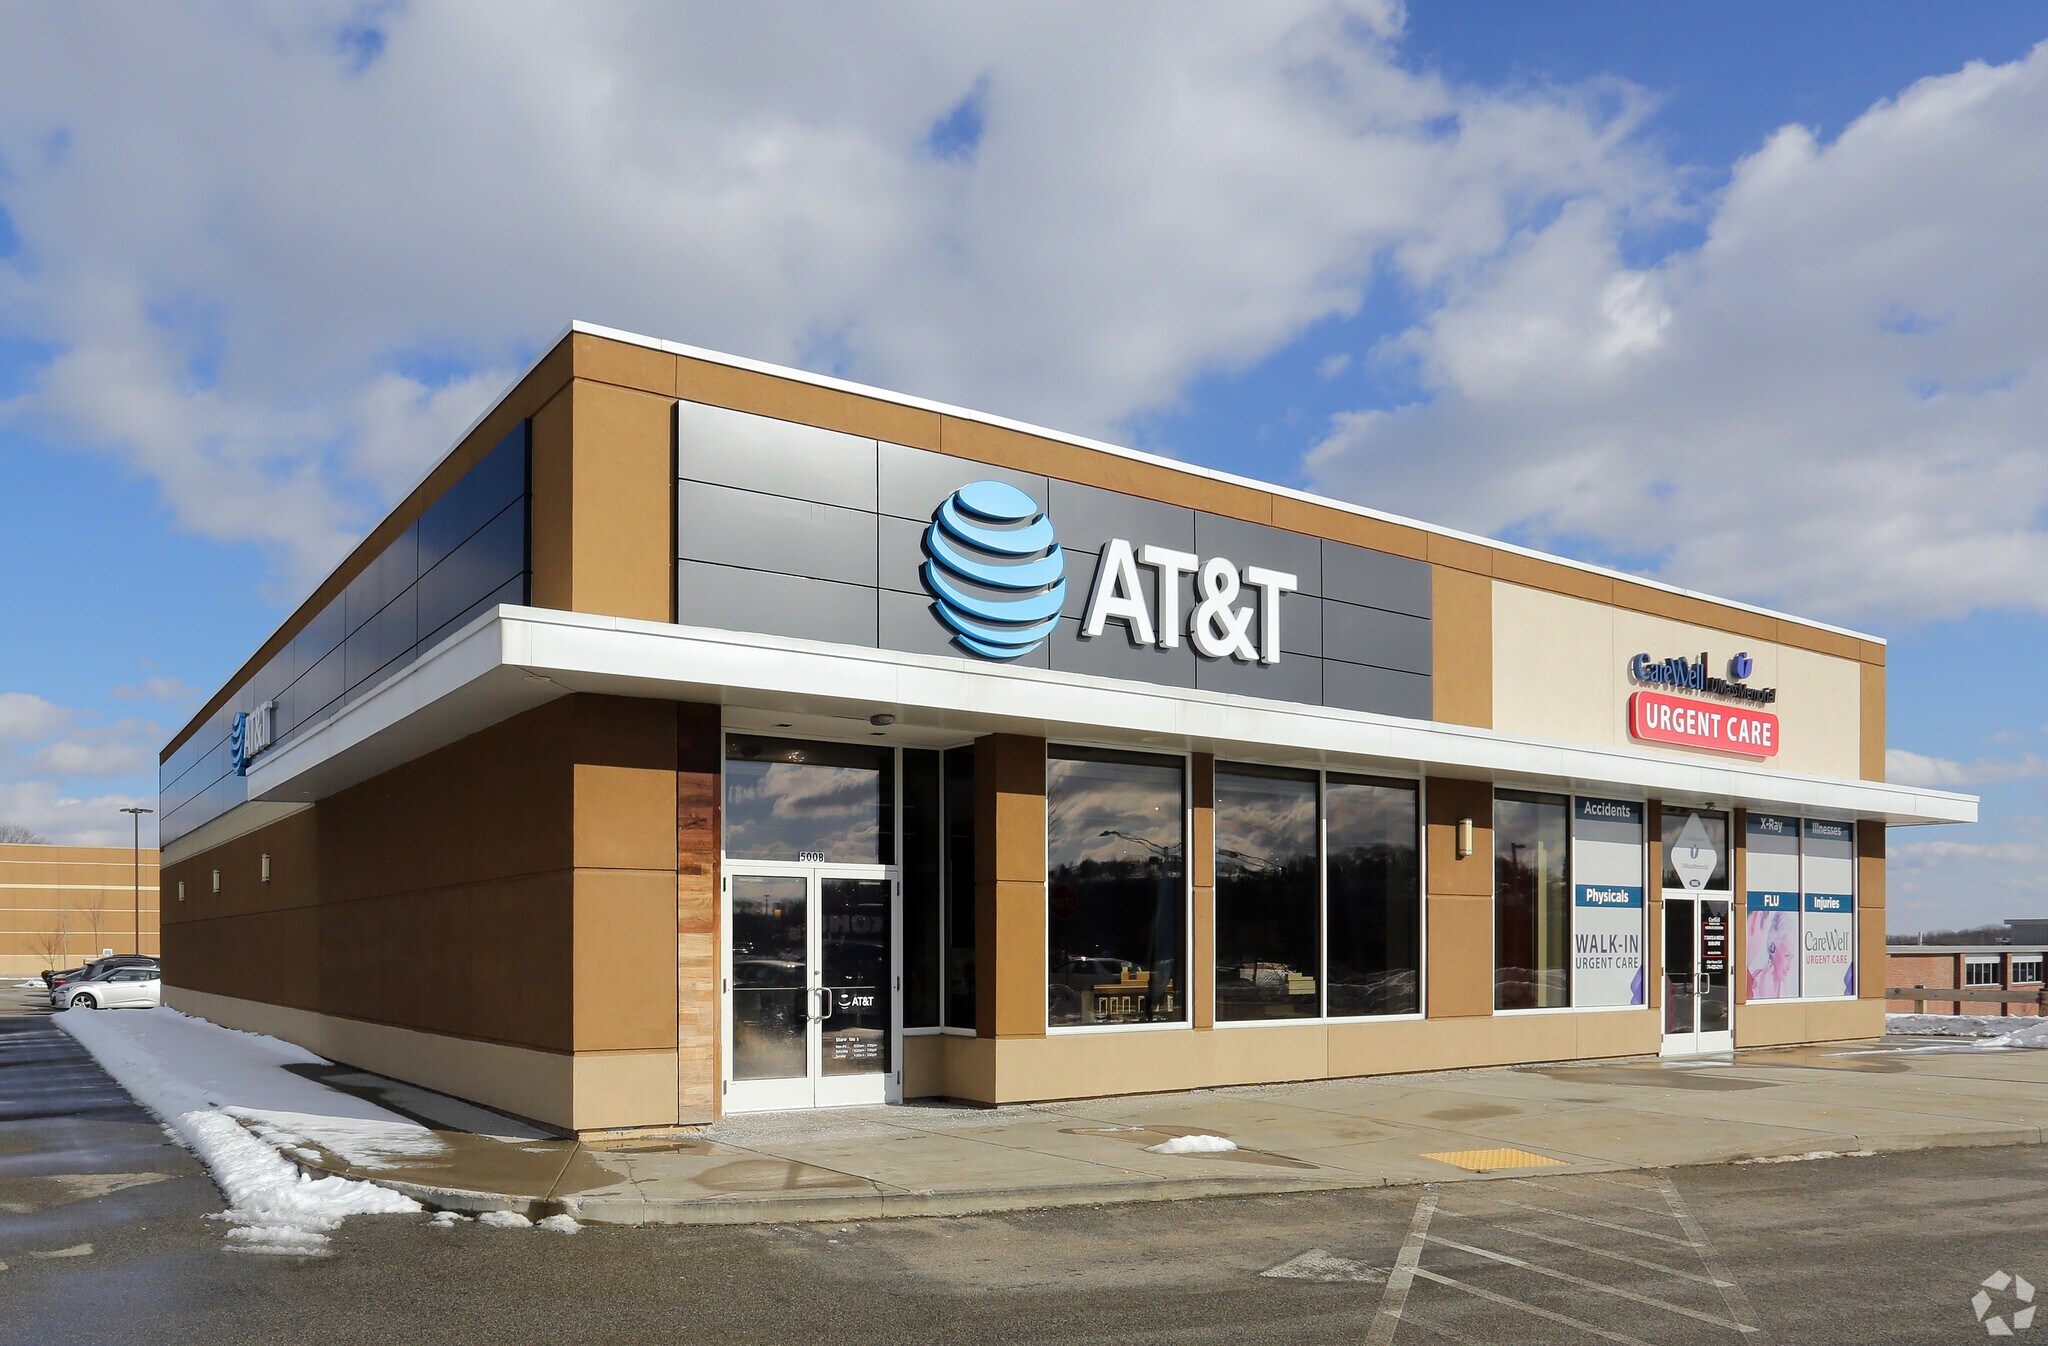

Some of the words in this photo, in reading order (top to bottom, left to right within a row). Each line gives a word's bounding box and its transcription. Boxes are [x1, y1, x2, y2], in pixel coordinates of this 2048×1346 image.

[1082, 538, 1298, 664] AT&T
[1633, 651, 1709, 692] CareWell
[1646, 702, 1722, 739] URGENT
[1726, 717, 1773, 747] CARE
[1584, 801, 1631, 818] Accidents
[1760, 817, 1783, 833] X-Ray
[1812, 822, 1842, 836] Illnesses
[800, 852, 824, 862] 500B
[1586, 888, 1629, 905] Physicals
[1764, 894, 1780, 907] FLU
[1814, 896, 1840, 910] Injuries
[1575, 934, 1639, 954] WALK-IN
[1804, 929, 1849, 952] CareWell
[1575, 957, 1613, 969] URGENT
[1615, 957, 1639, 969] CARE
[1806, 955, 1830, 964] URGENT
[1832, 955, 1848, 964] CARE
[851, 996, 874, 1007] AT&T
